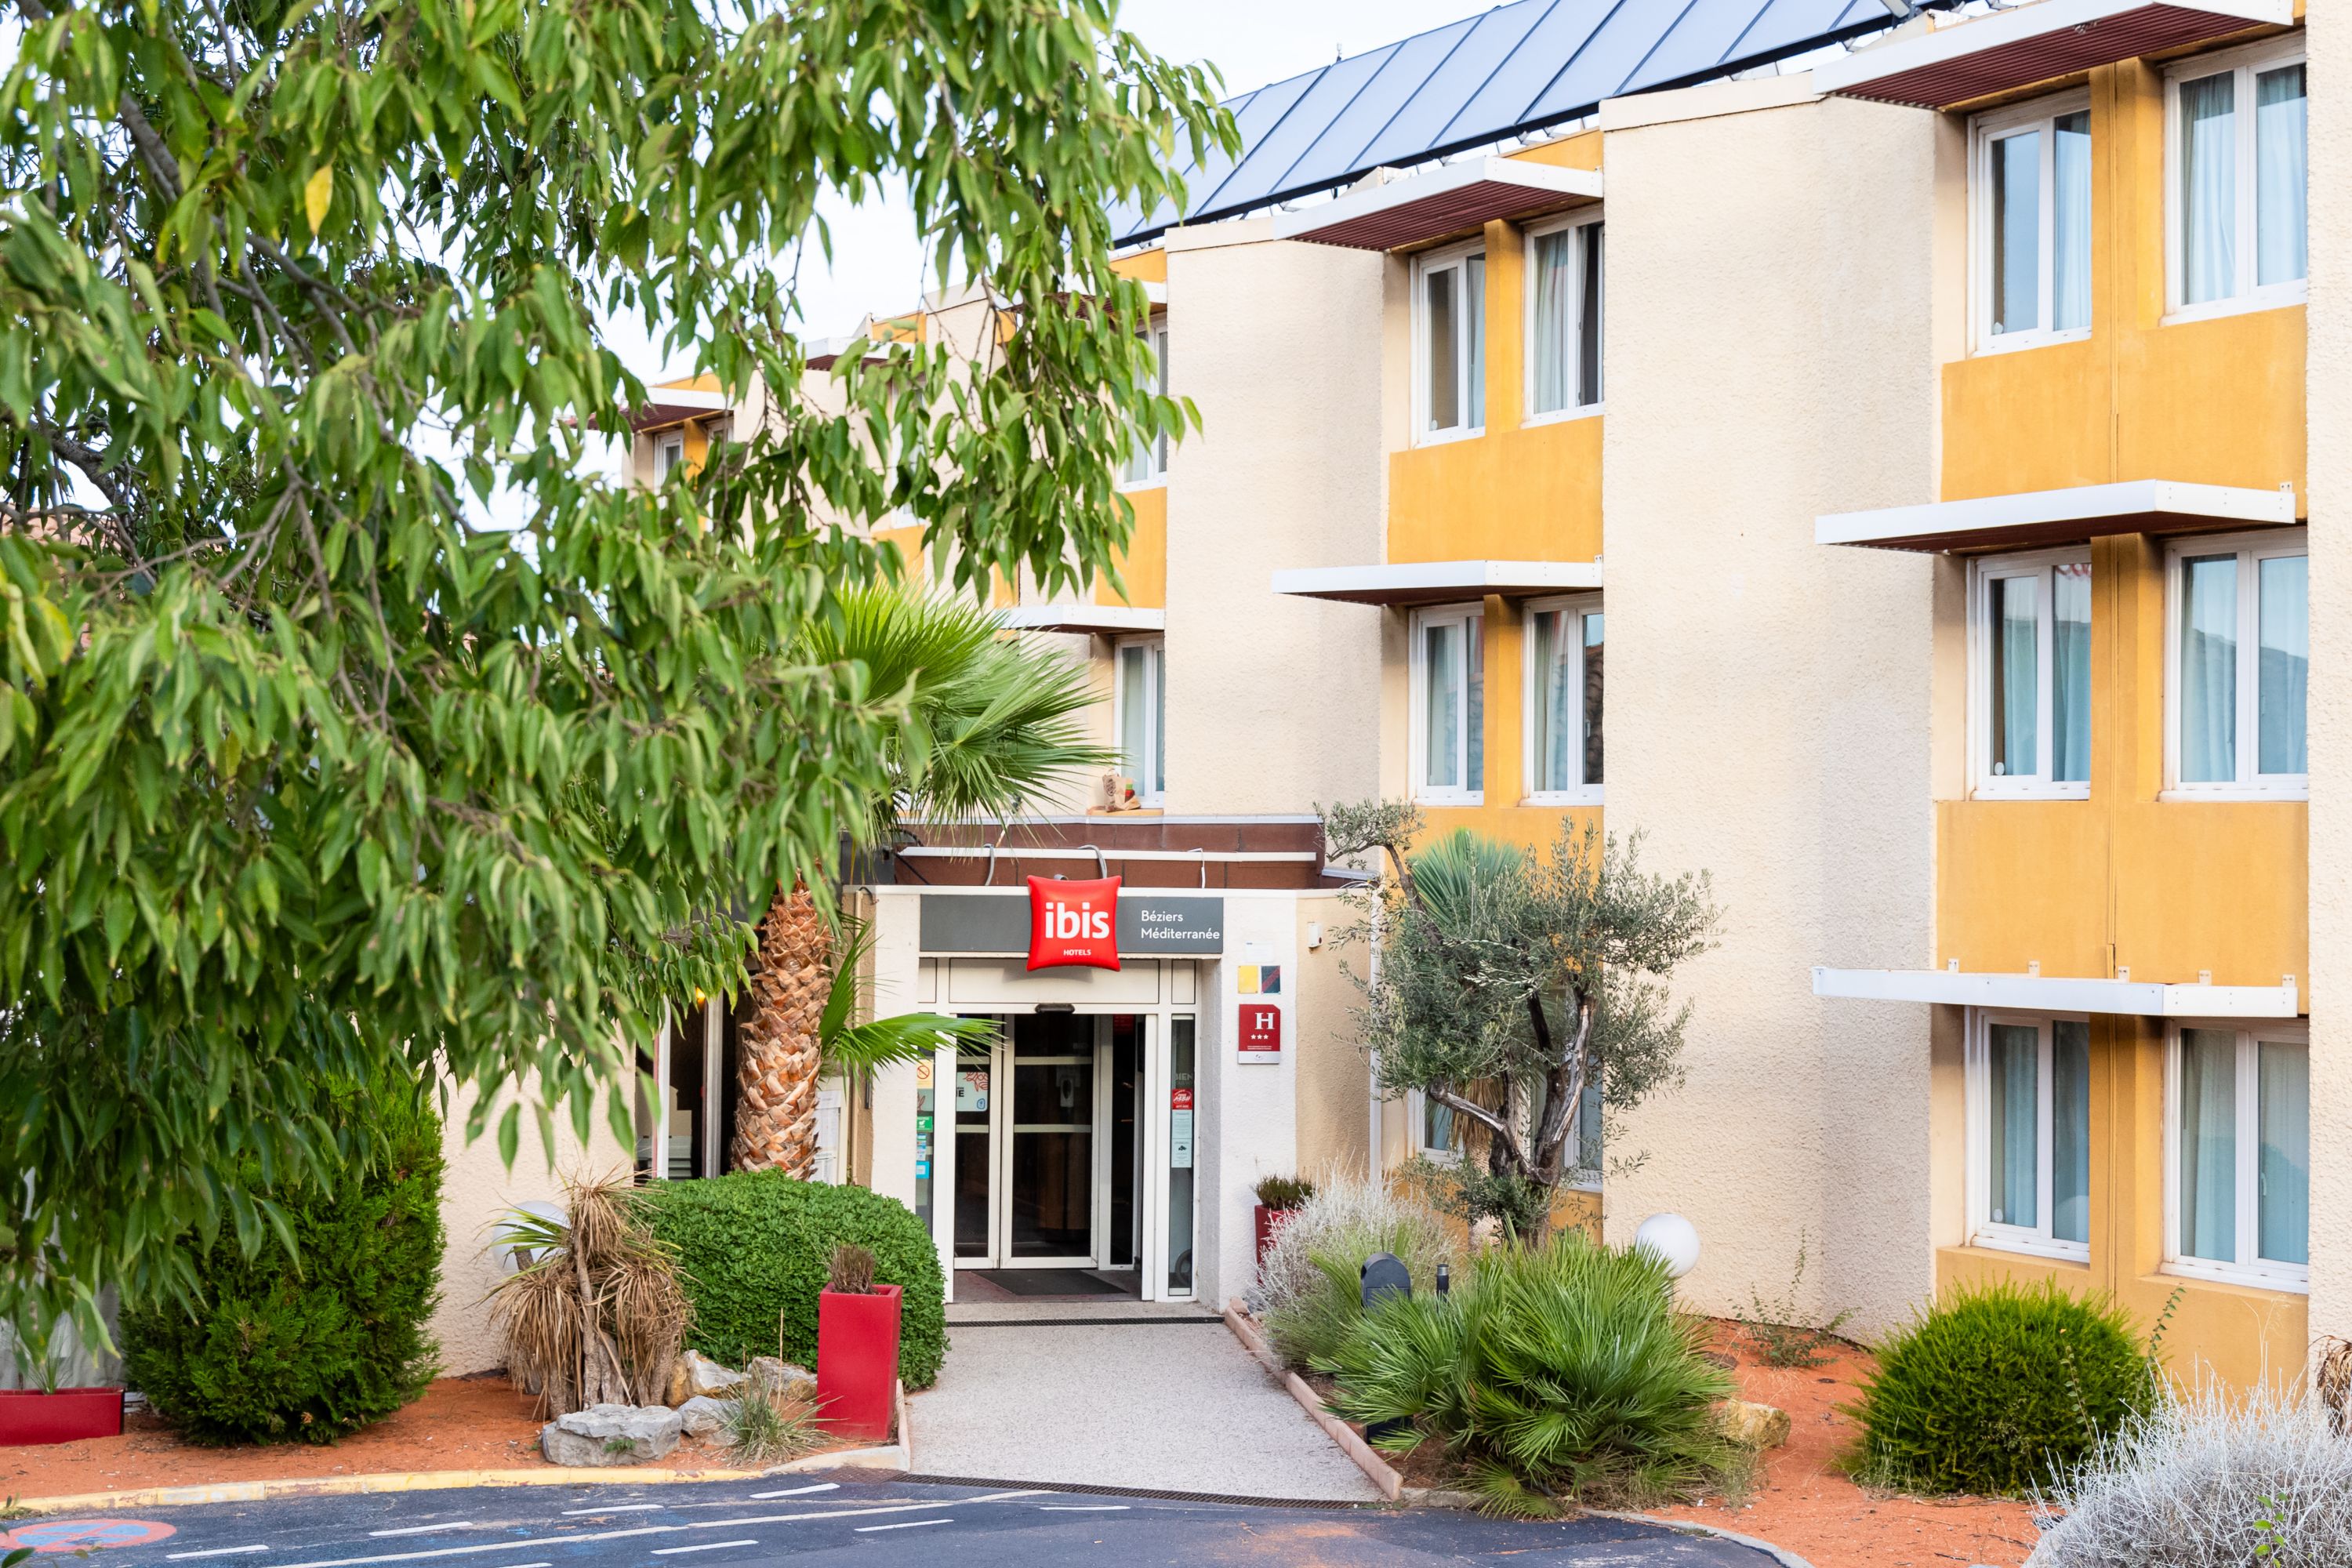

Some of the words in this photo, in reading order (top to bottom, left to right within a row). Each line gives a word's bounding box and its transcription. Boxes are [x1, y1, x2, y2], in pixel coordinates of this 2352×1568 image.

[1045, 902, 1110, 939] ibis
[1141, 909, 1184, 922] Béziers
[1141, 927, 1221, 940] Méditerranée
[1254, 1012, 1276, 1030] H
